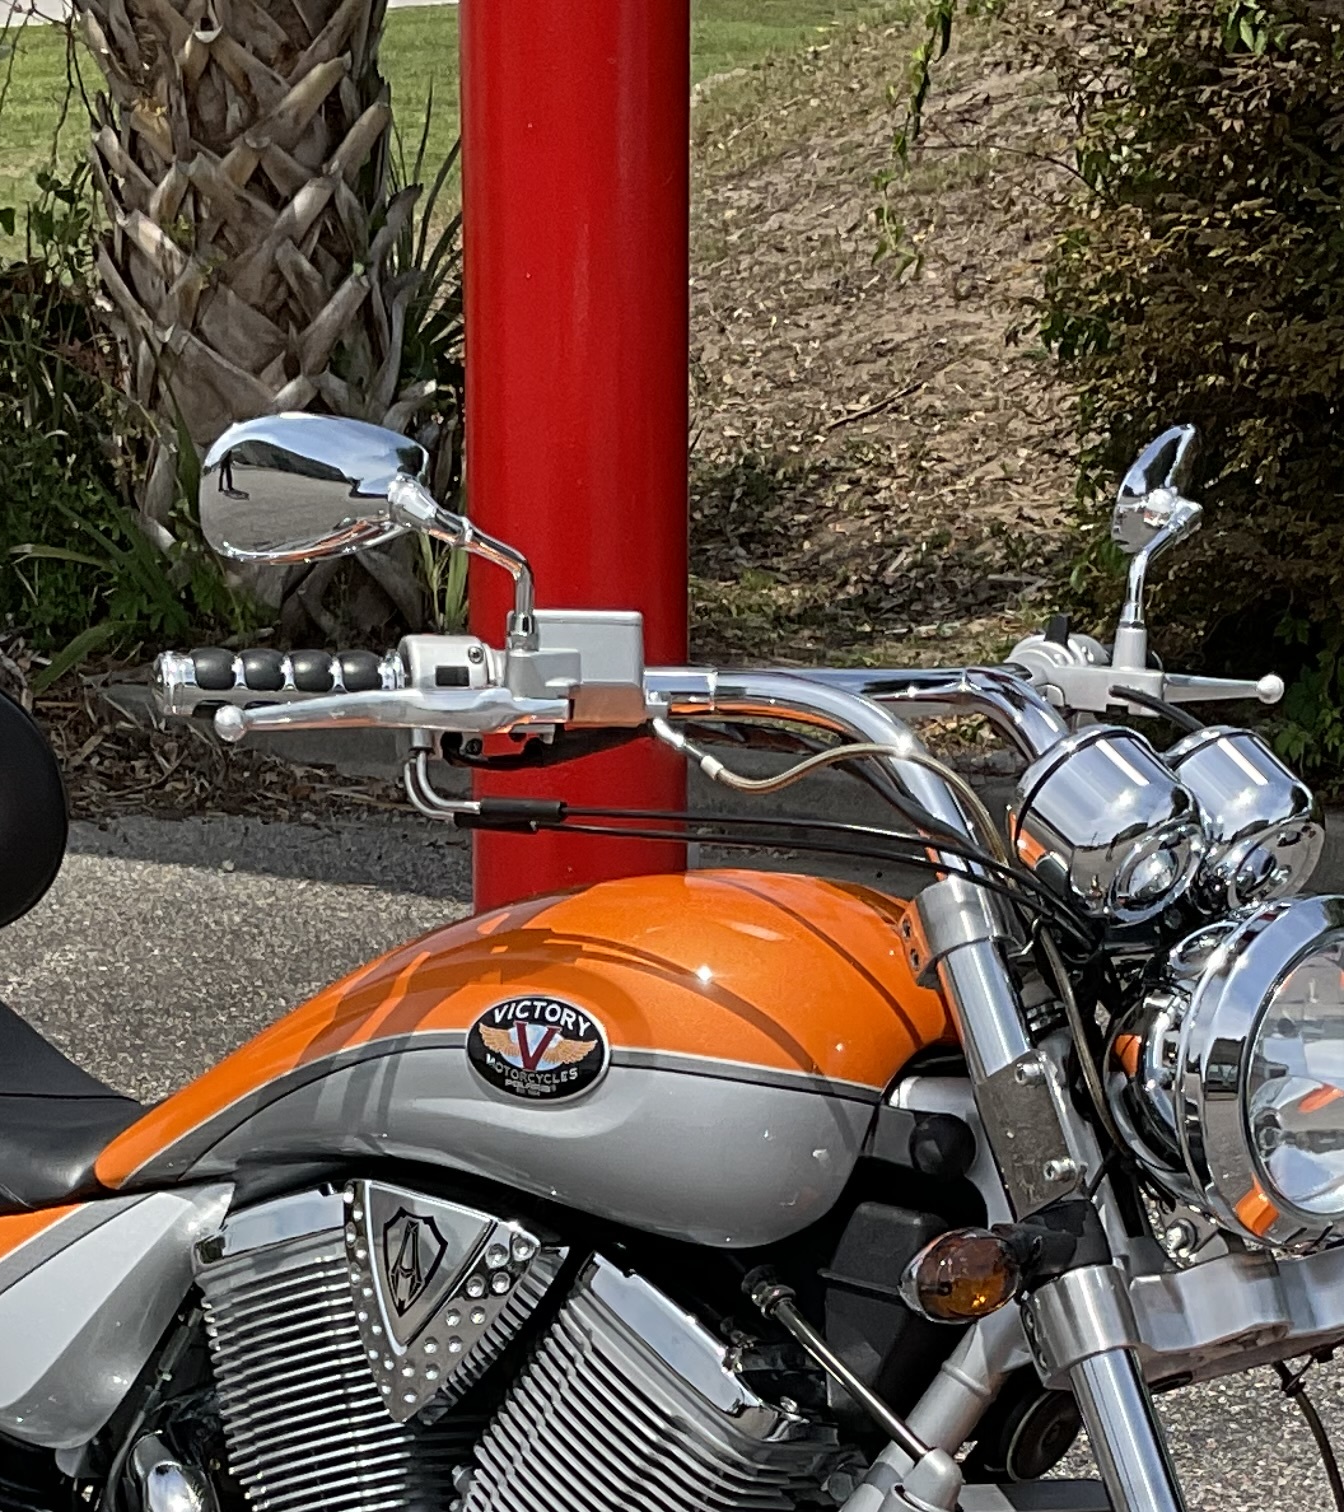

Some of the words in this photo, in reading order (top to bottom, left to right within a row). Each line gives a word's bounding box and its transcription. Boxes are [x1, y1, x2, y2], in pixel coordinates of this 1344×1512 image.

[494, 1001, 591, 1036] VICTORY
[513, 1020, 562, 1073] V
[485, 1053, 578, 1085] MOTORCYCLES
